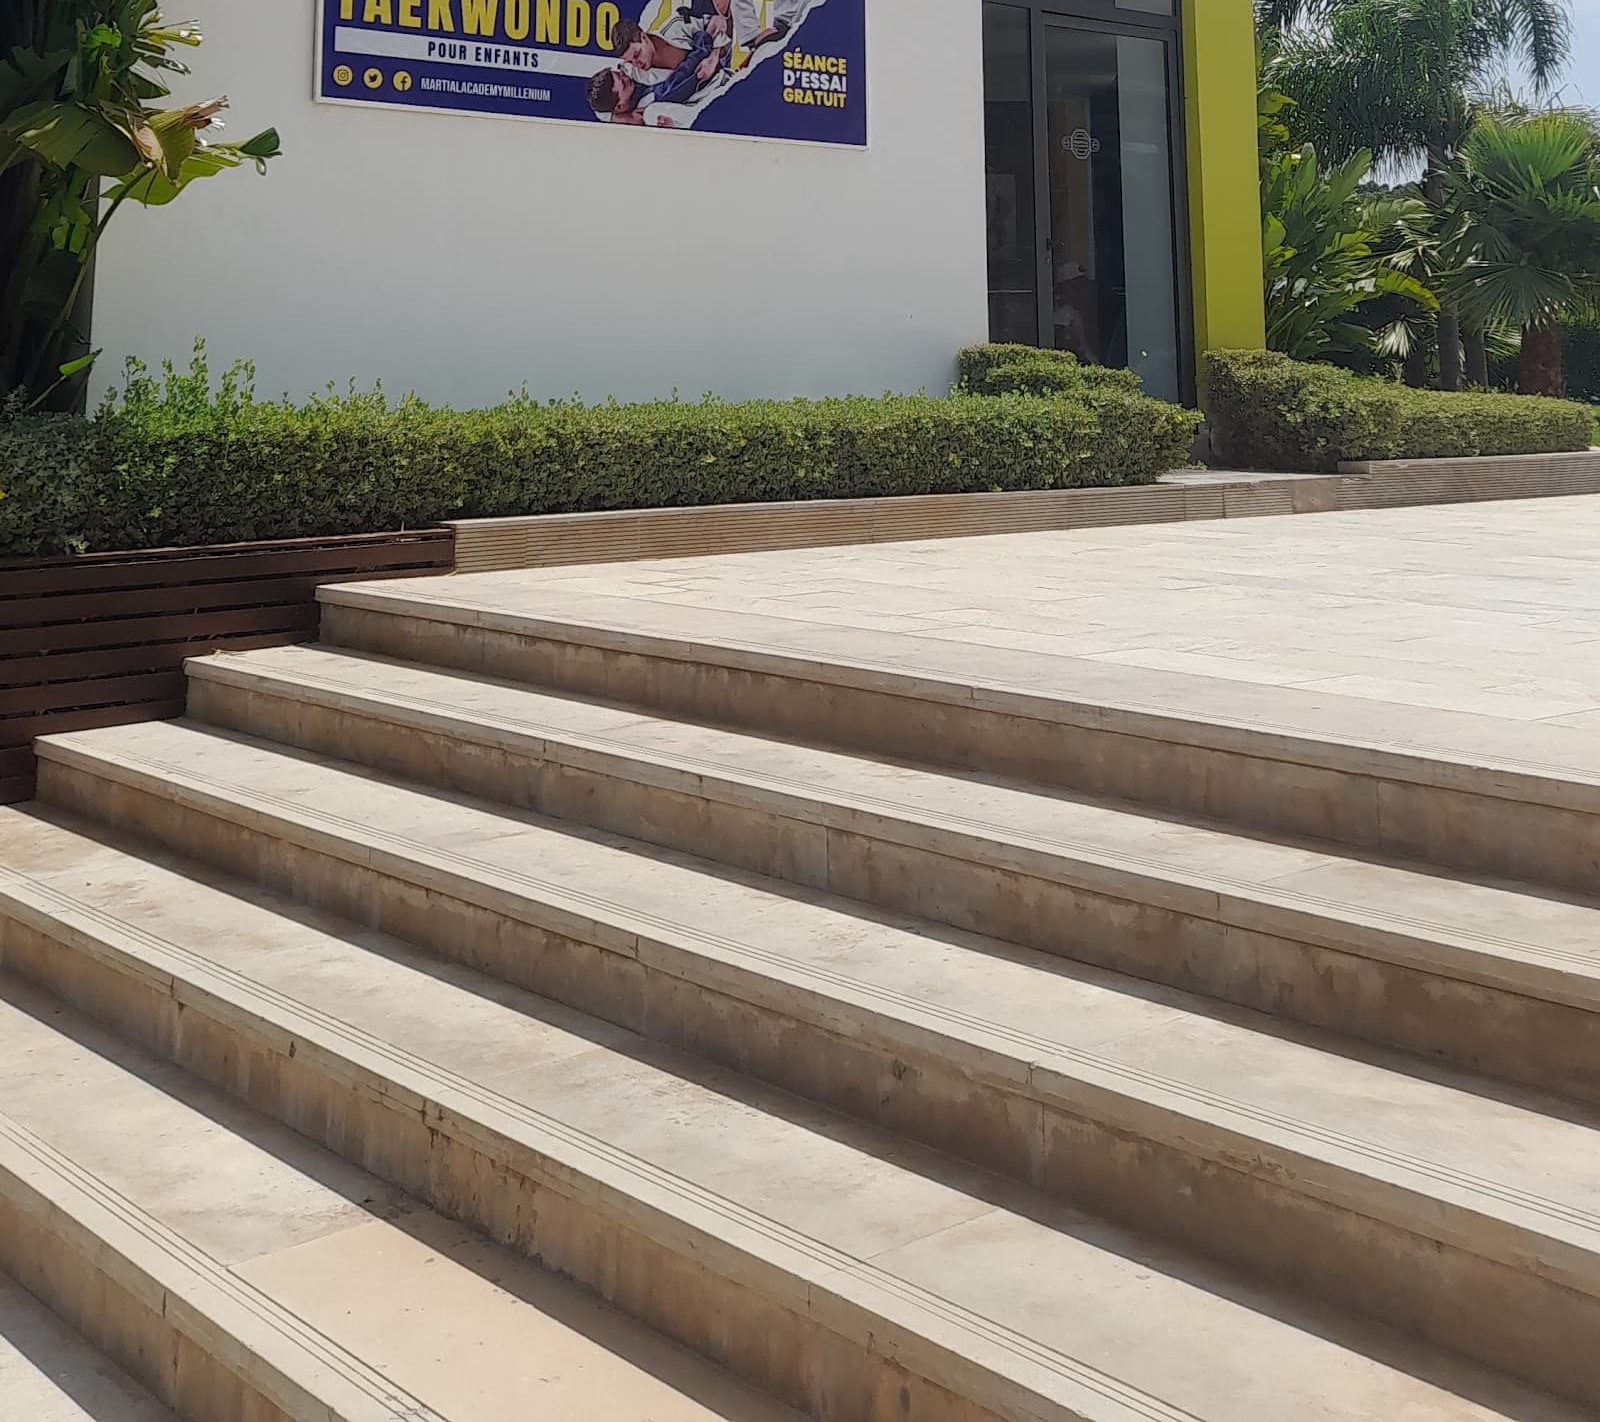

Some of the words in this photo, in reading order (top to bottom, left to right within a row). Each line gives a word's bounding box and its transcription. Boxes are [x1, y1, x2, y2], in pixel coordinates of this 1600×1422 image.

[427, 41, 468, 60] POUR
[475, 46, 540, 68] ENFANTS
[783, 47, 847, 74] SÉANCE
[421, 77, 551, 101] MARTIALACADEMYMILLENIUM
[783, 69, 847, 92] D'ESSAI
[783, 87, 847, 108] GRATUIT
